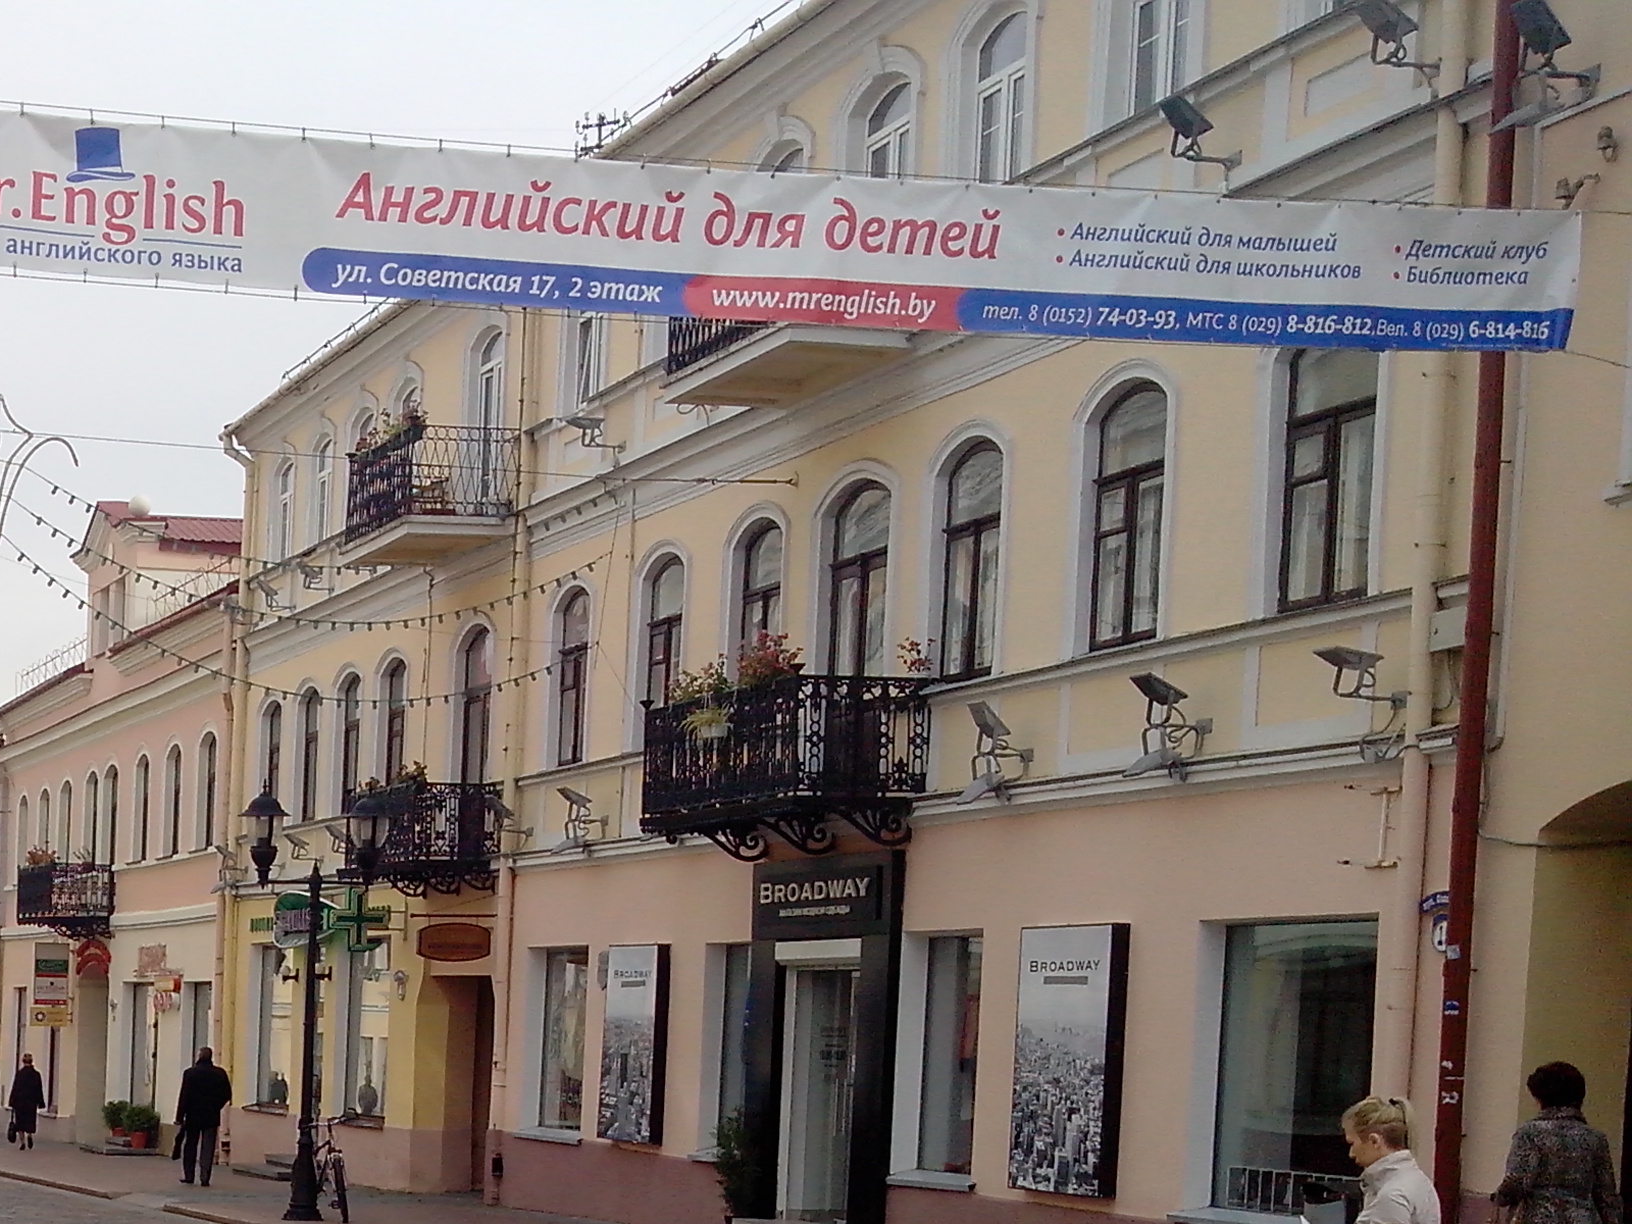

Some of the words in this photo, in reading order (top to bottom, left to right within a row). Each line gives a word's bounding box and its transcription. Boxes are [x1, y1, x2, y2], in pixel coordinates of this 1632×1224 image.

[335, 171, 685, 244] Английский
[704, 191, 806, 248] для
[825, 197, 1001, 260] детей
[1070, 222, 1193, 246] Английский
[1197, 226, 1233, 249] для
[1236, 233, 1337, 253] малышей
[1404, 239, 1497, 261] Детский
[1500, 241, 1549, 262] клуб
[6, 238, 161, 267] английского
[172, 253, 243, 273] языка
[1069, 249, 1191, 273] Английский
[1196, 254, 1232, 276] для
[1236, 259, 1361, 279] школьников
[331, 261, 371, 288] ул.
[379, 262, 521, 293] Советская
[529, 275, 559, 300] 17,
[568, 277, 581, 298] 2
[587, 279, 661, 303] этаж
[1406, 265, 1529, 286] Библиотека
[712, 287, 936, 322] www.mrenglish.by
[982, 304, 1023, 320] тел.
[1028, 304, 1038, 321] 8
[1043, 305, 1093, 325] (0152)
[1096, 307, 1180, 329] 74-03-93,
[1186, 312, 1224, 330] МТС
[1228, 314, 1237, 331] 8
[1241, 314, 1282, 335] (029)
[1413, 320, 1421, 337] 8
[1426, 321, 1465, 341] (029)
[1469, 320, 1550, 340] 6-814-816
[760, 877, 871, 904] BROADWAY
[1029, 960, 1101, 973] BROADWAY
